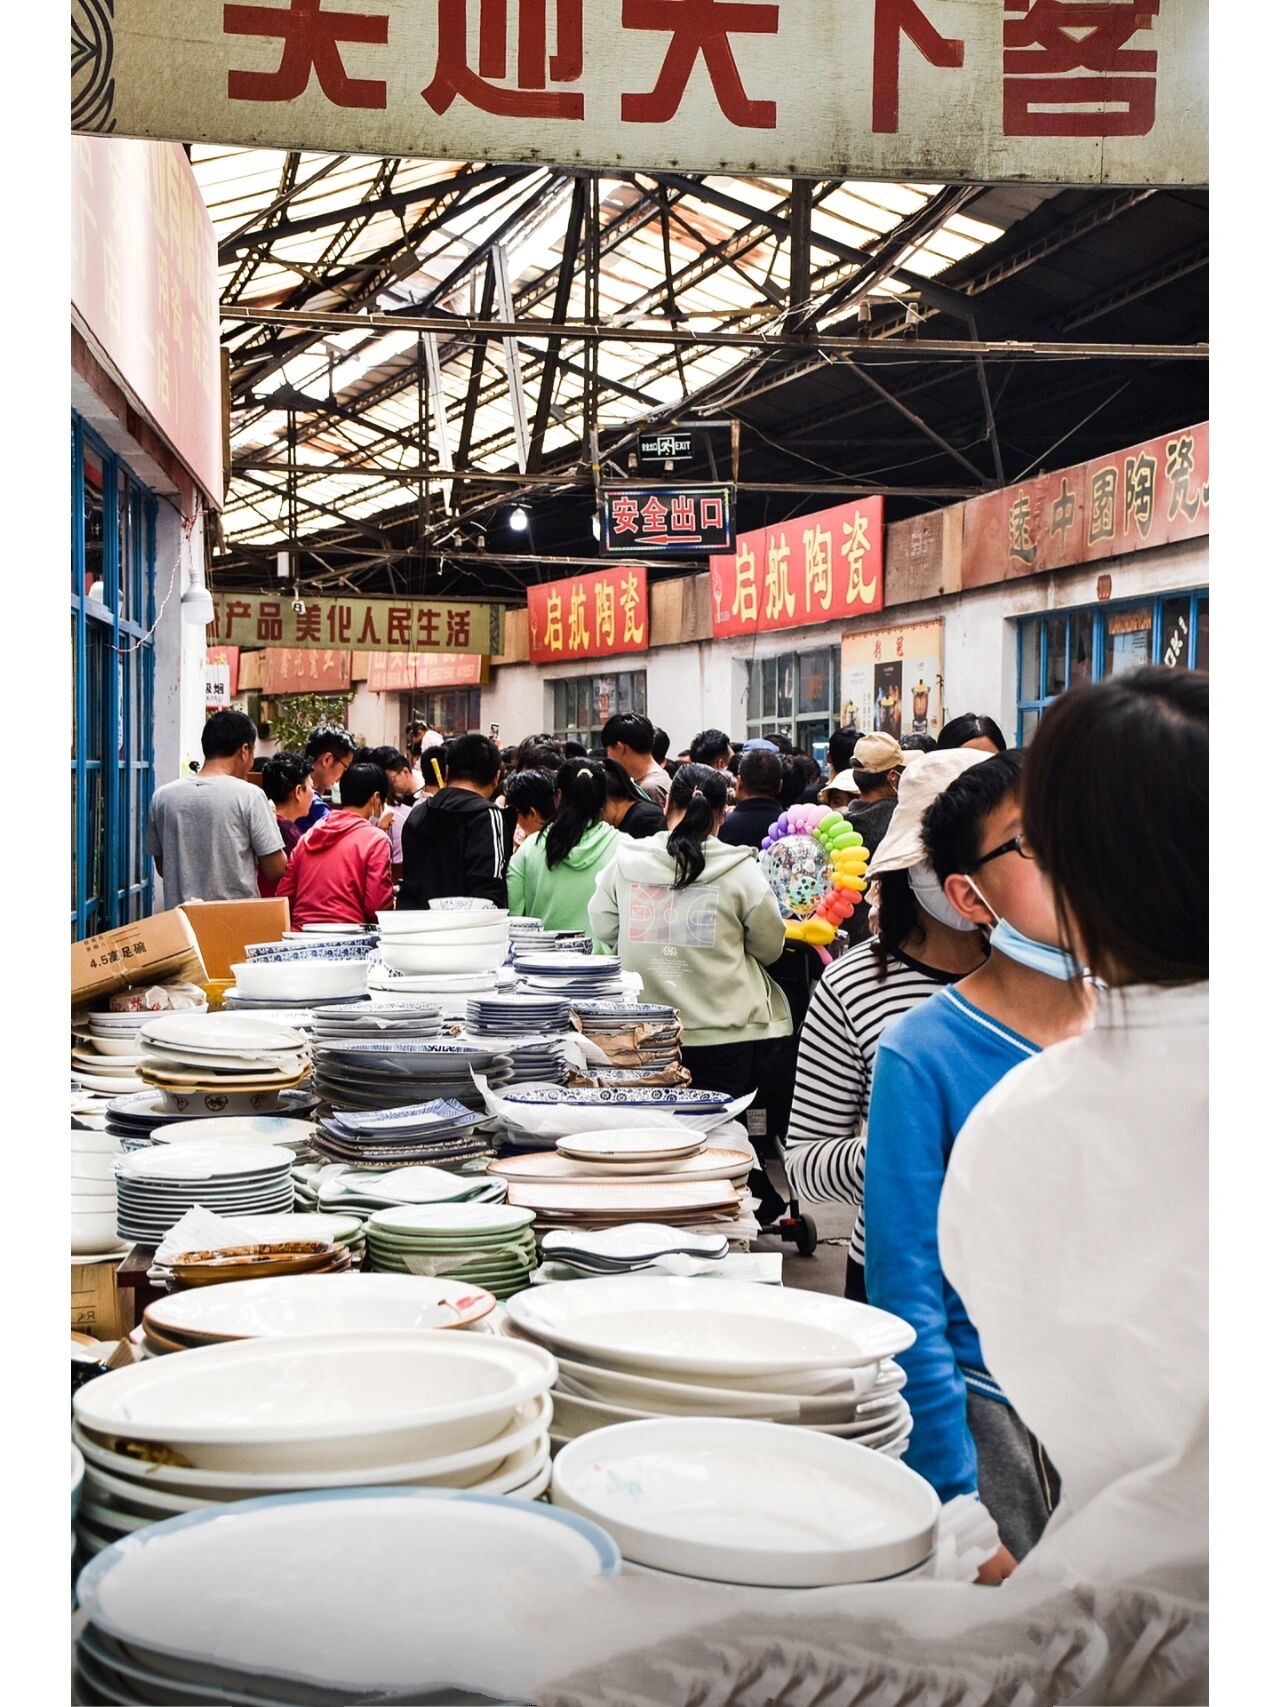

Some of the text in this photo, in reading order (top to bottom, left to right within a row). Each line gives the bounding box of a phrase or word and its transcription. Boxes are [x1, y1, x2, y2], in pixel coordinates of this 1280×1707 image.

[676, 441, 690, 450] EXIT
[612, 496, 723, 533] 安全出口
[732, 510, 876, 623] 启航陶瓷
[296, 604, 469, 646] 美化人民生活
[544, 571, 644, 652] 启航陶瓷
